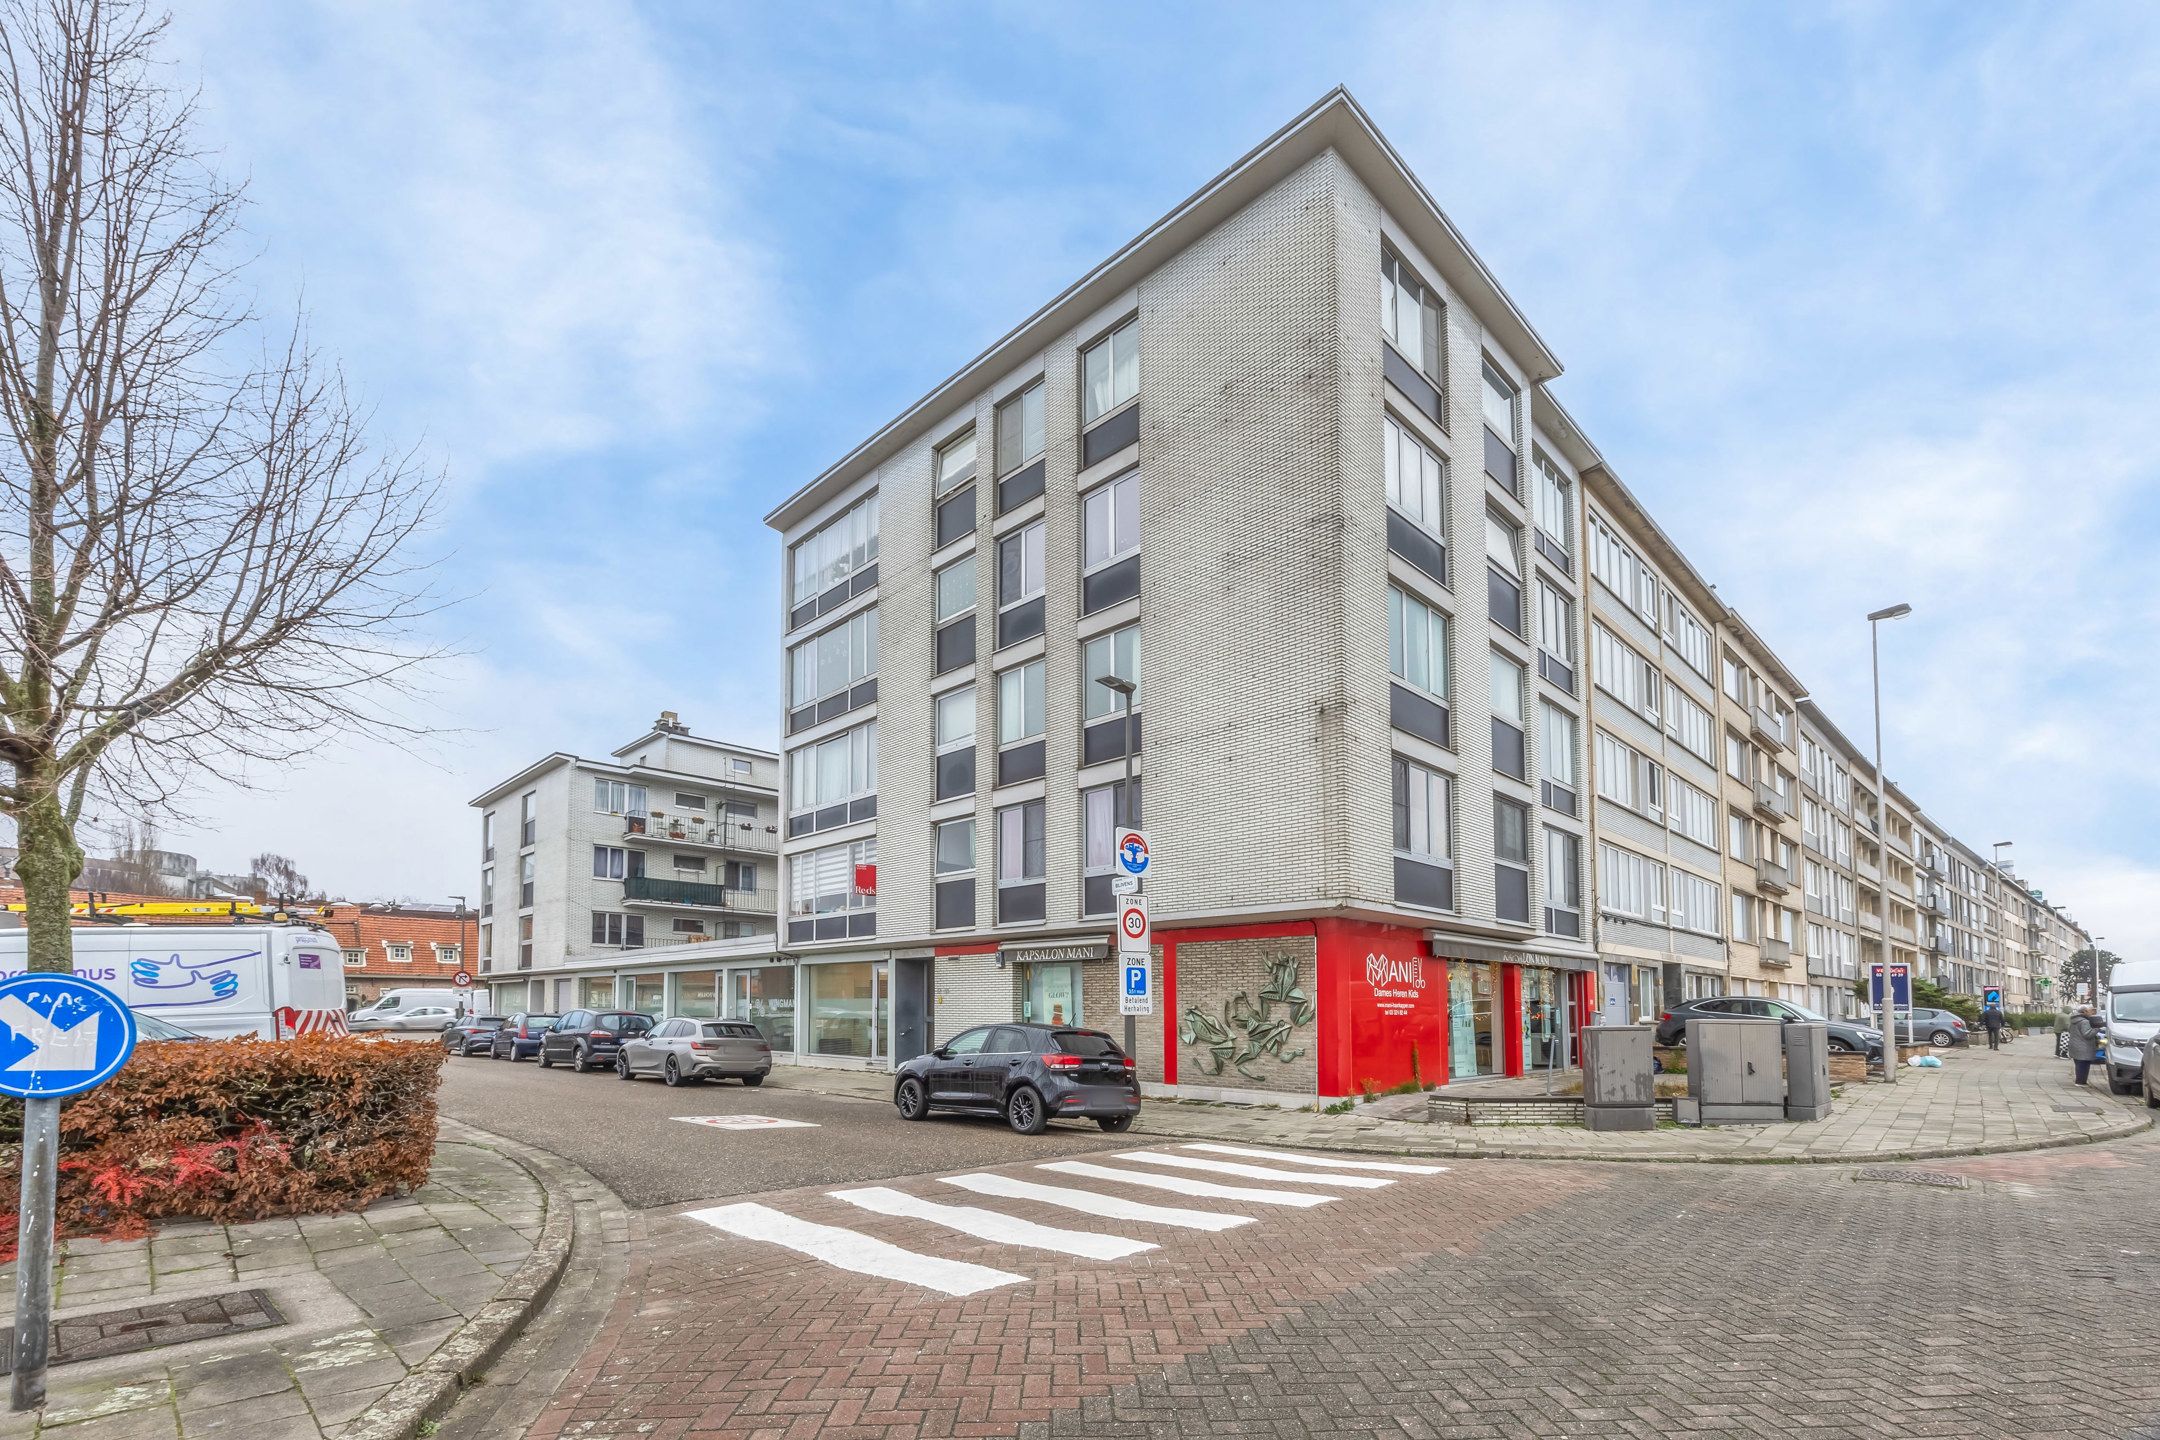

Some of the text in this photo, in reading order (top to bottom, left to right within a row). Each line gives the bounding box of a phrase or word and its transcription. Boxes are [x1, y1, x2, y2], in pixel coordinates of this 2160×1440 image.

[855, 886, 876, 894] Reds
[1128, 918, 1141, 929] 30
[1016, 947, 1094, 960] KAPSALON MANI
[1127, 957, 1145, 966] ZONE
[1366, 953, 1412, 987] MANI
[1131, 969, 1142, 988] P
[1374, 987, 1419, 998] Dames Heren Kids
[1125, 996, 1148, 1004] Betalend
[1124, 1005, 1150, 1013] Herhaling
